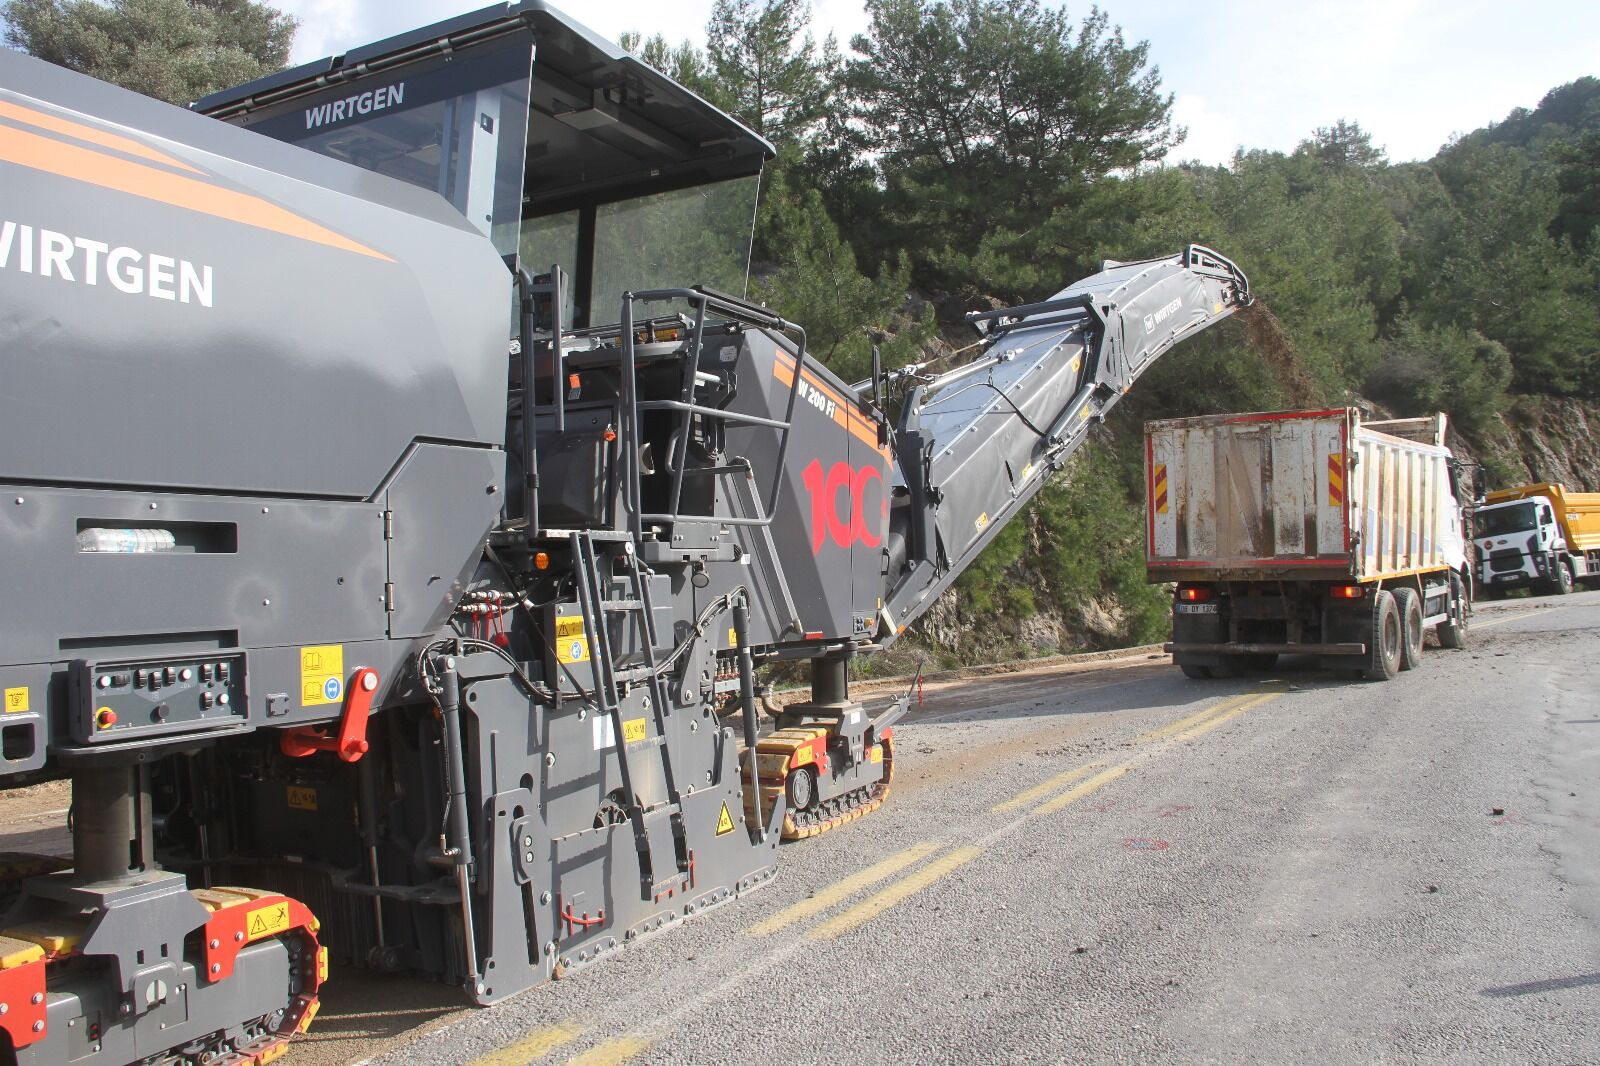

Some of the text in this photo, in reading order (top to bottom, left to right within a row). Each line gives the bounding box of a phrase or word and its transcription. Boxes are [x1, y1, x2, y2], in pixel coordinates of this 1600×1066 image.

[305, 82, 405, 129] WIRTGEN
[1153, 295, 1183, 325] WIRTGEN
[798, 378, 809, 399] W
[807, 387, 826, 412] 200
[801, 457, 887, 558] 100
